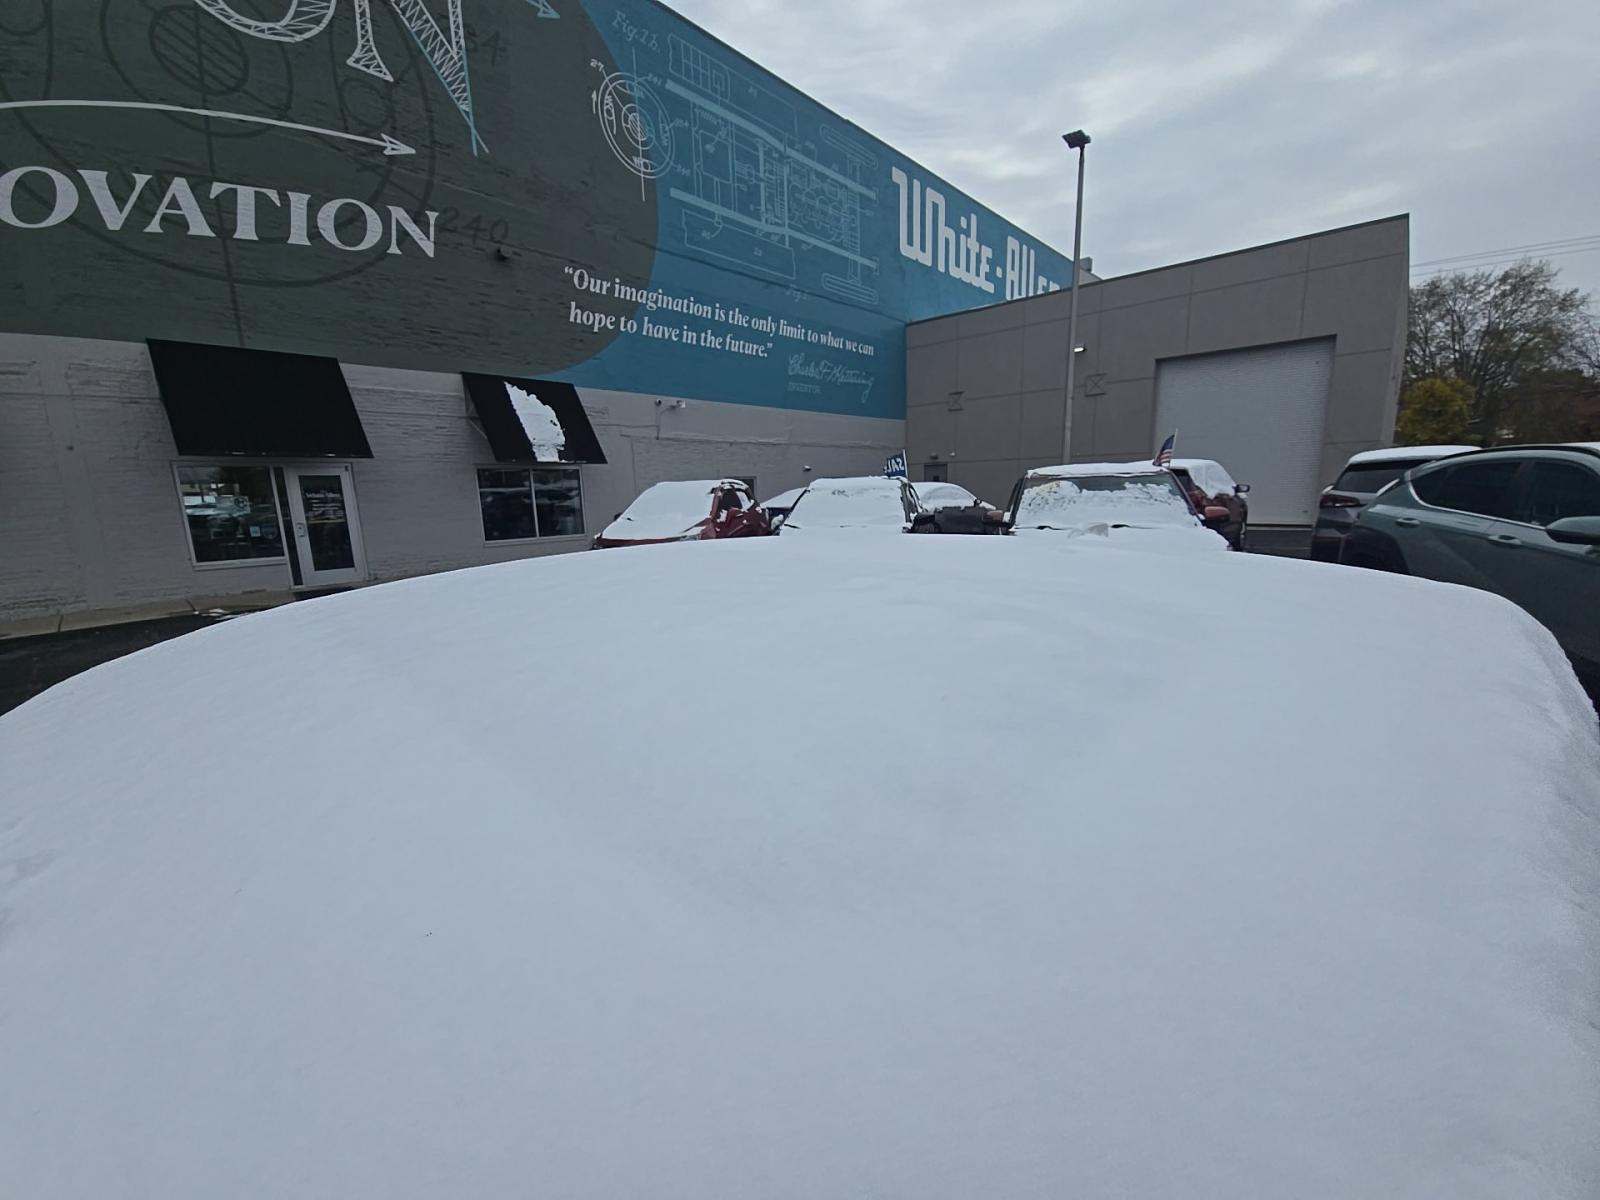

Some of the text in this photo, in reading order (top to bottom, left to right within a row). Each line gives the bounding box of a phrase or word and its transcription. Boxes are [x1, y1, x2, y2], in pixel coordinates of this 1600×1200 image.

[0, 165, 439, 257] OVATION
[564, 265, 875, 357] “Our imagination is the only limit to what we can
[569, 300, 773, 358] hope to have in the future.”
